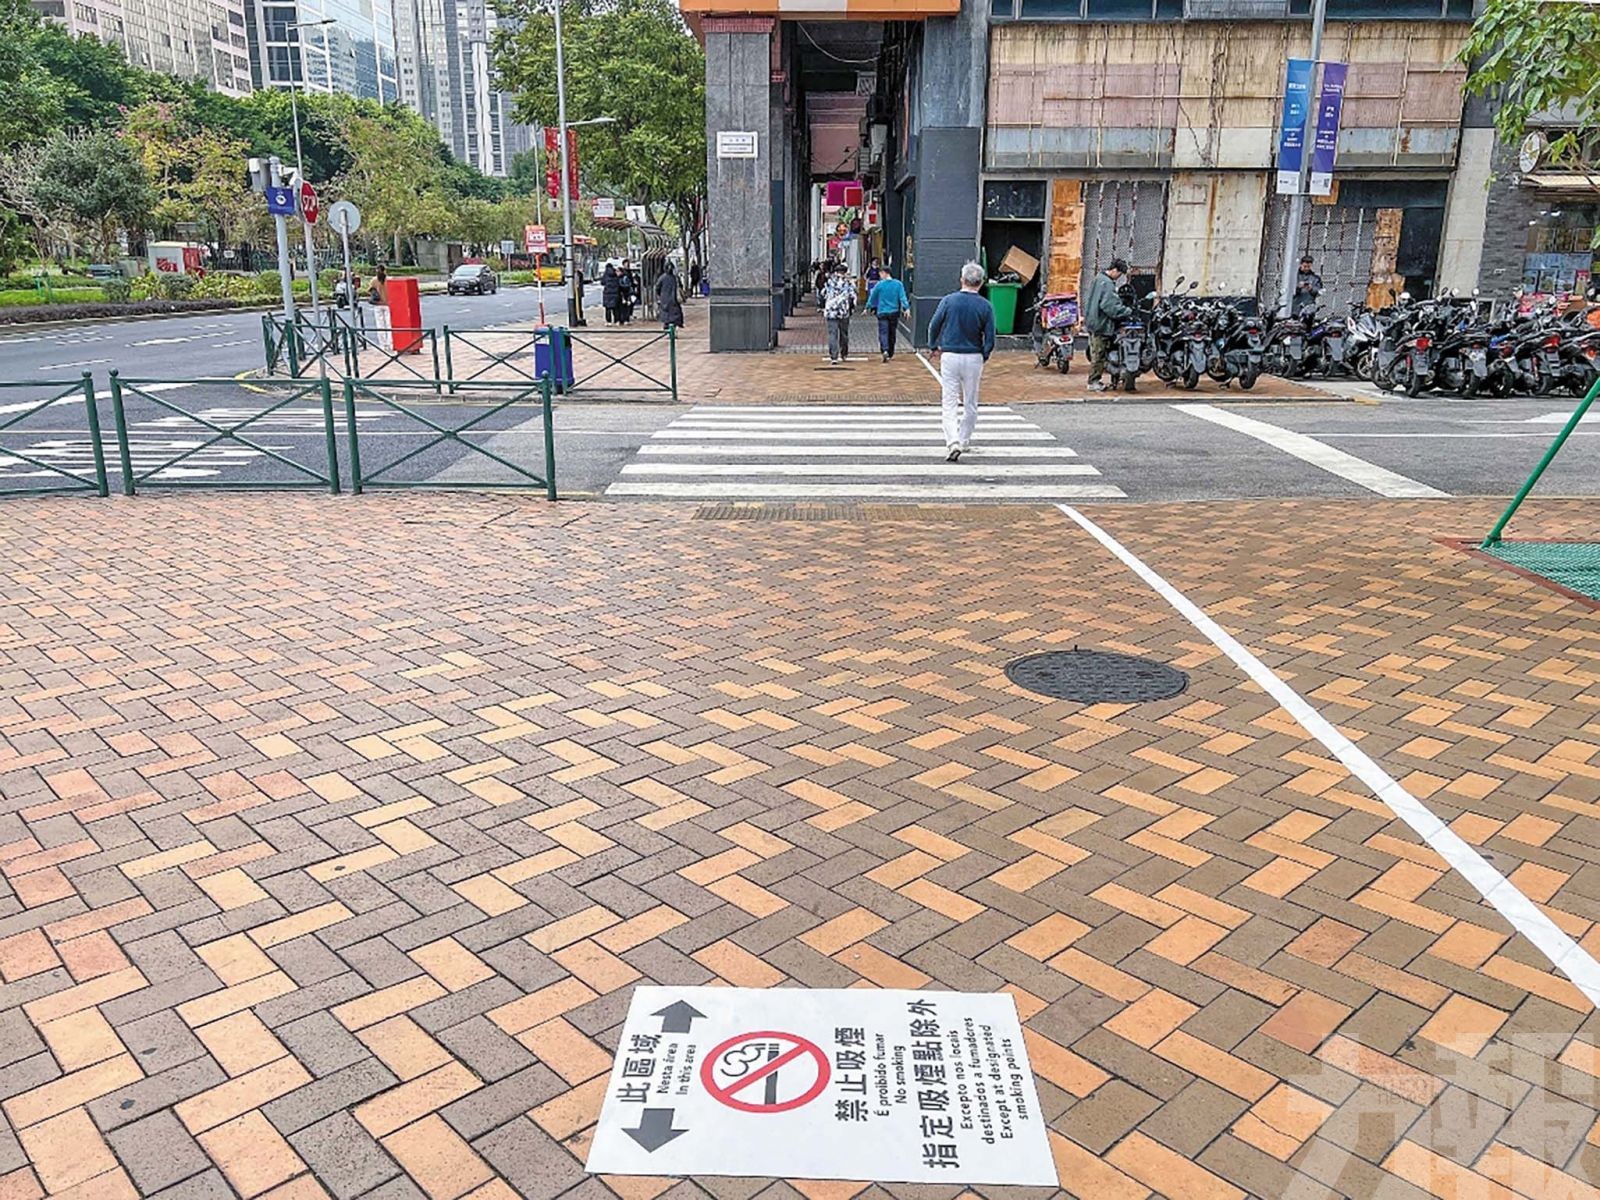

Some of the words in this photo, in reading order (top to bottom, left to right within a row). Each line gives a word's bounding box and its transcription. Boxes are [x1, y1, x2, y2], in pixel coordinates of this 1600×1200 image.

[685, 1044, 697, 1063] area
[872, 1033, 886, 1060] fumar
[947, 1030, 962, 1059] locais
[963, 1017, 982, 1069] fumadores
[978, 1024, 1002, 1081] designated
[1002, 1038, 1020, 1071] points
[615, 1034, 662, 1103] 此區域
[656, 1065, 674, 1094] Nesta
[677, 1065, 692, 1083] this
[834, 1027, 869, 1122] 禁止吸煙
[891, 1045, 906, 1085] smoking
[953, 1061, 965, 1079] nos
[675, 1085, 689, 1095] In
[874, 1062, 892, 1107] proibido
[893, 1088, 907, 1104] No
[906, 999, 960, 1168] 指定吸煙點除外
[993, 1085, 1006, 1096] at
[1009, 1074, 1029, 1120] smoking
[873, 1109, 890, 1117] É
[960, 1084, 974, 1130] Excepto
[974, 1081, 995, 1144] destinados
[999, 1099, 1014, 1140] Except
